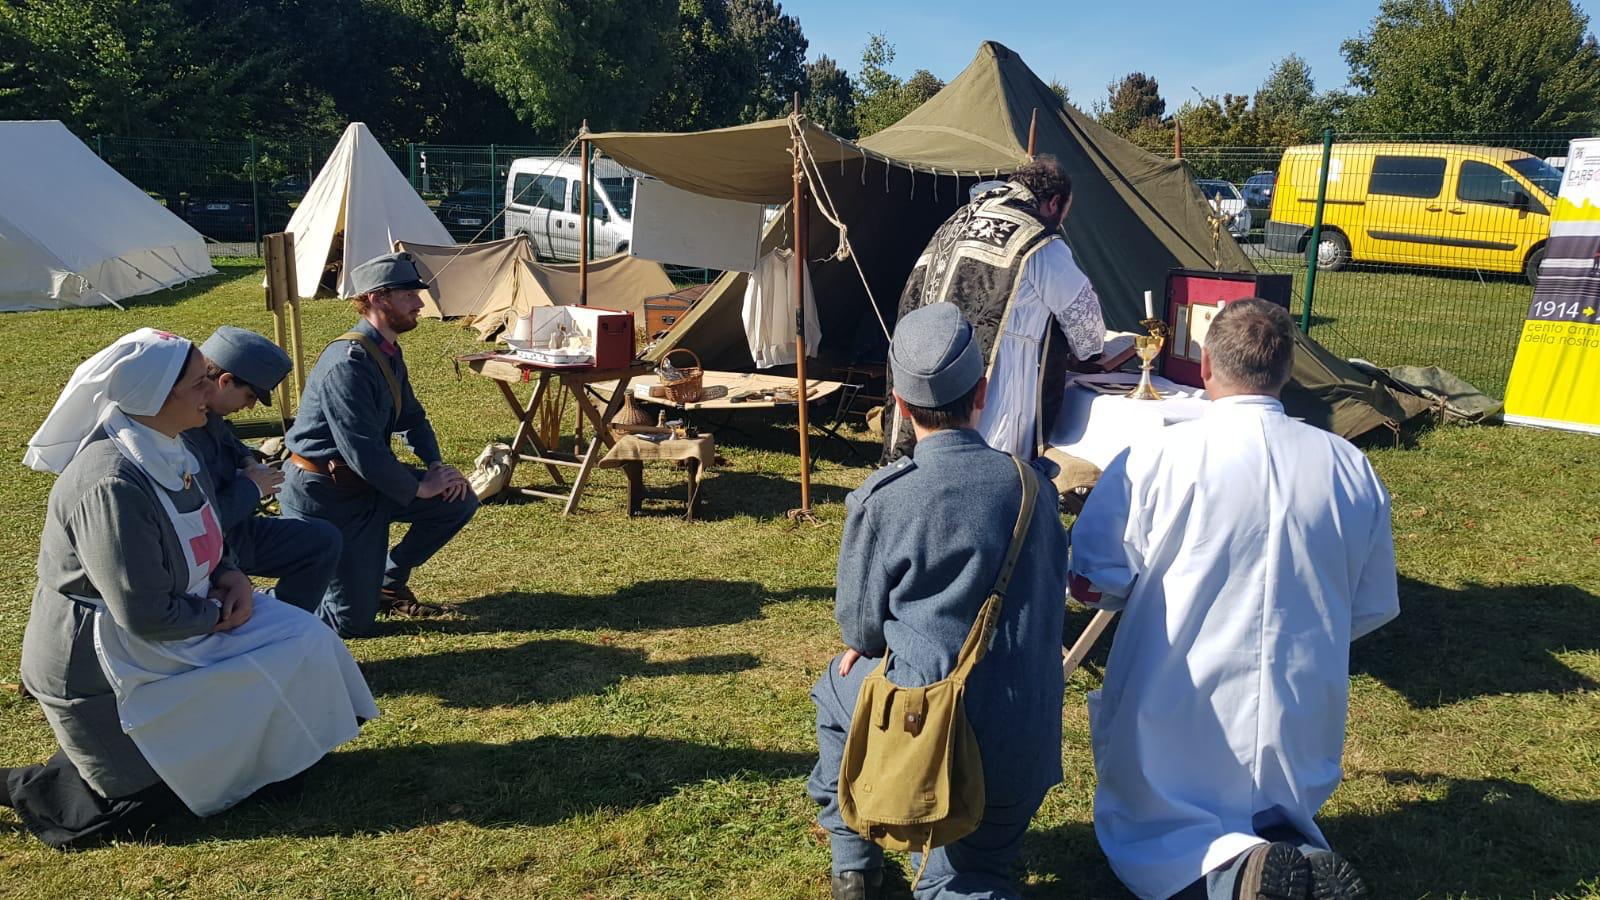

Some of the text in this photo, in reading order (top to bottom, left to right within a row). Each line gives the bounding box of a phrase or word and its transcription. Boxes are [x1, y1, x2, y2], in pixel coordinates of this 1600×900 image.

[1534, 300, 1580, 318] 1914
[1527, 322, 1599, 337] cento anni
[1524, 333, 1600, 348] della nostra
